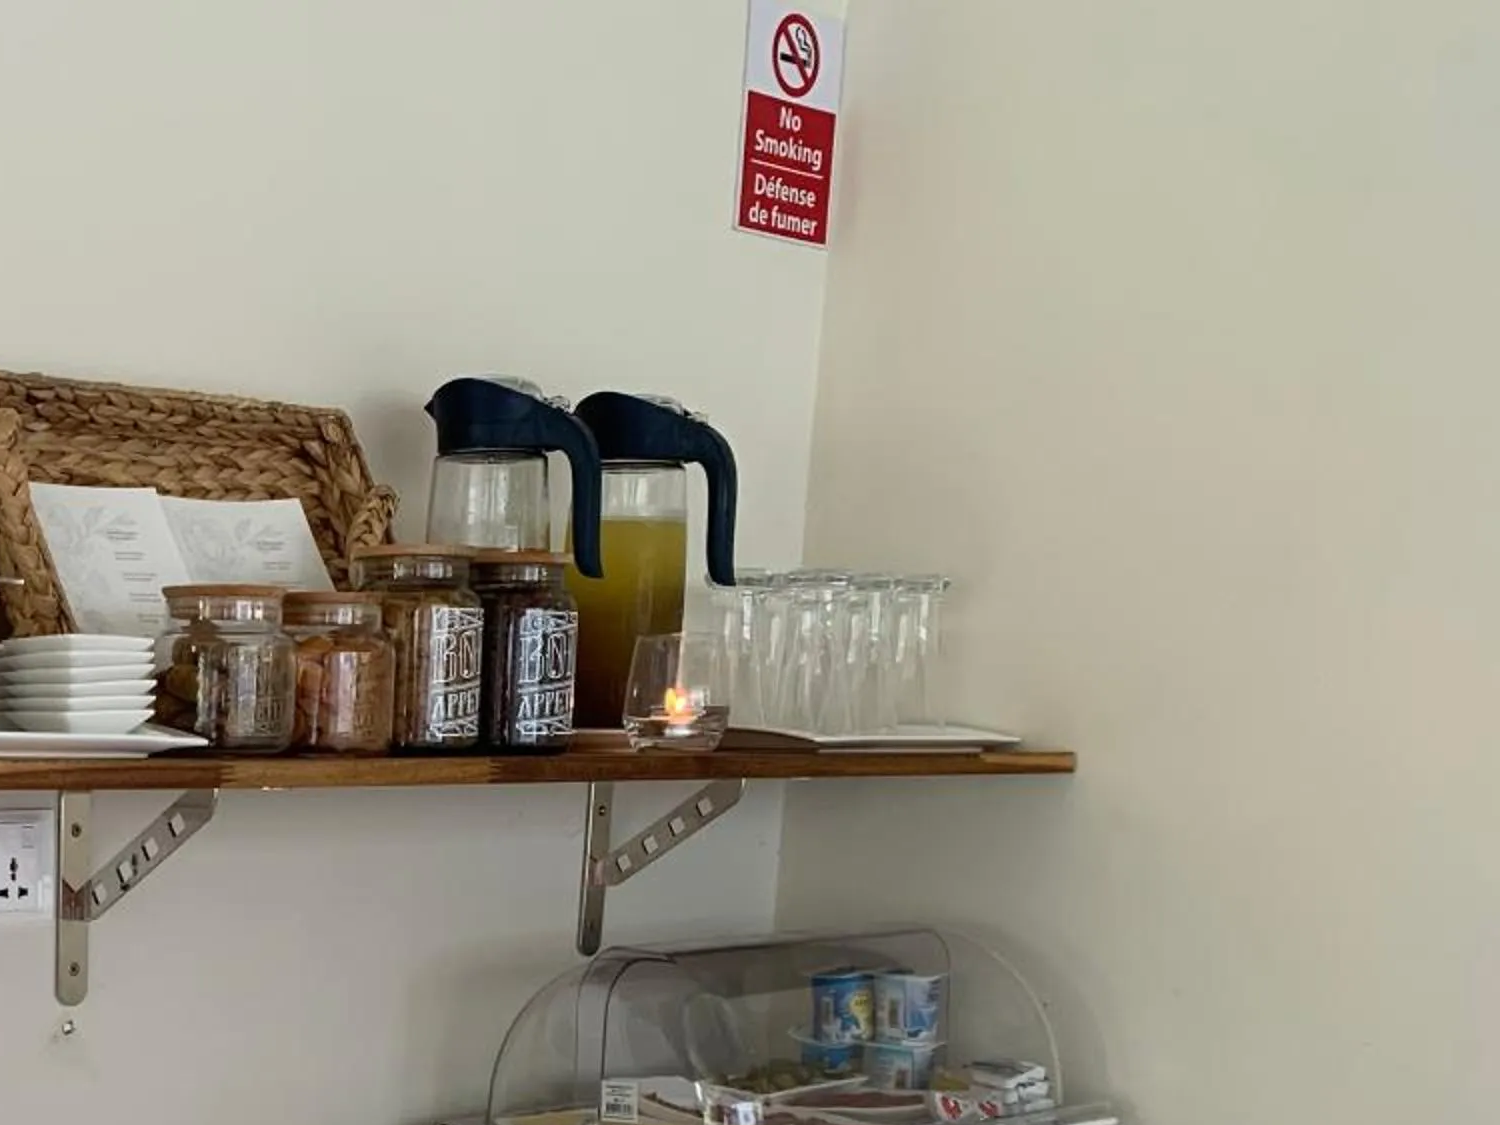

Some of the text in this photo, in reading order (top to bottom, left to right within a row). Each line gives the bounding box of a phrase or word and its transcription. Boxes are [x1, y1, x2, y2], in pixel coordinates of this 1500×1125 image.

[779, 106, 802, 131] No
[754, 130, 822, 170] Smoking
[754, 173, 816, 207] Défense
[748, 202, 817, 235] de fumer
